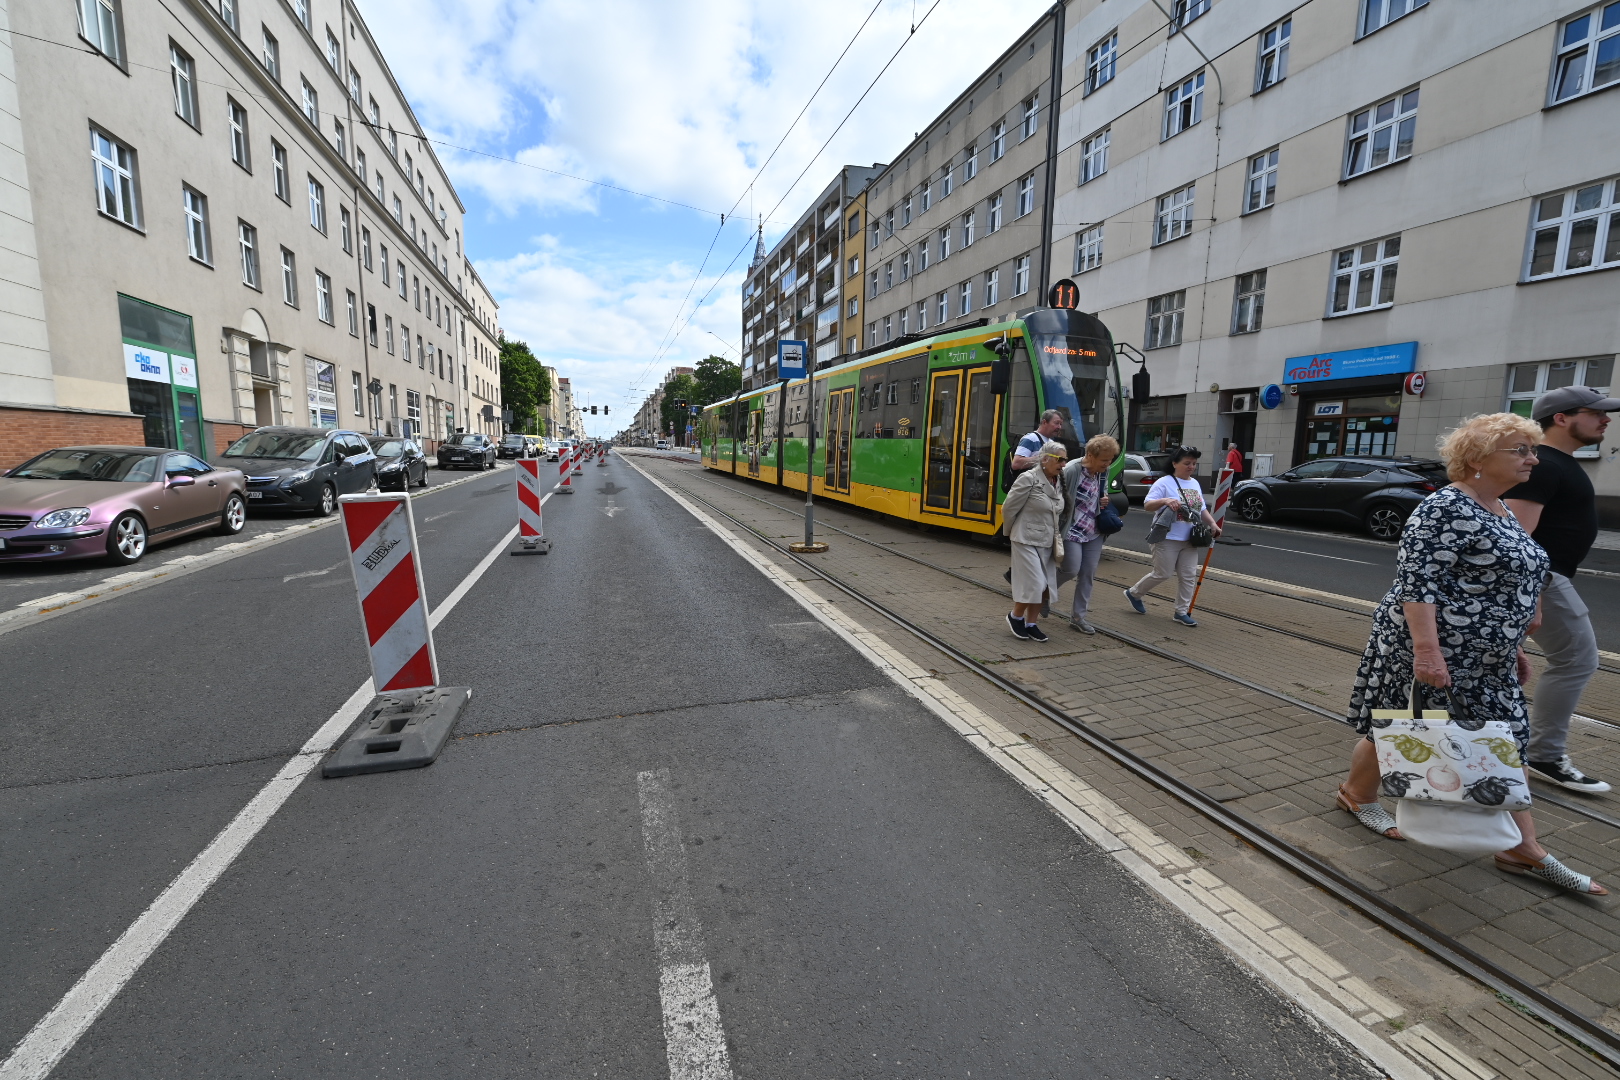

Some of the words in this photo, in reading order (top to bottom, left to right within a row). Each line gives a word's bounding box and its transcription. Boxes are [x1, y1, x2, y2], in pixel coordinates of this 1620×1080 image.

[1056, 284, 1074, 309] 11
[1078, 348, 1084, 356] 5
[1309, 357, 1334, 370] Arc
[1288, 367, 1332, 381] Tours
[1318, 405, 1340, 414] LOT
